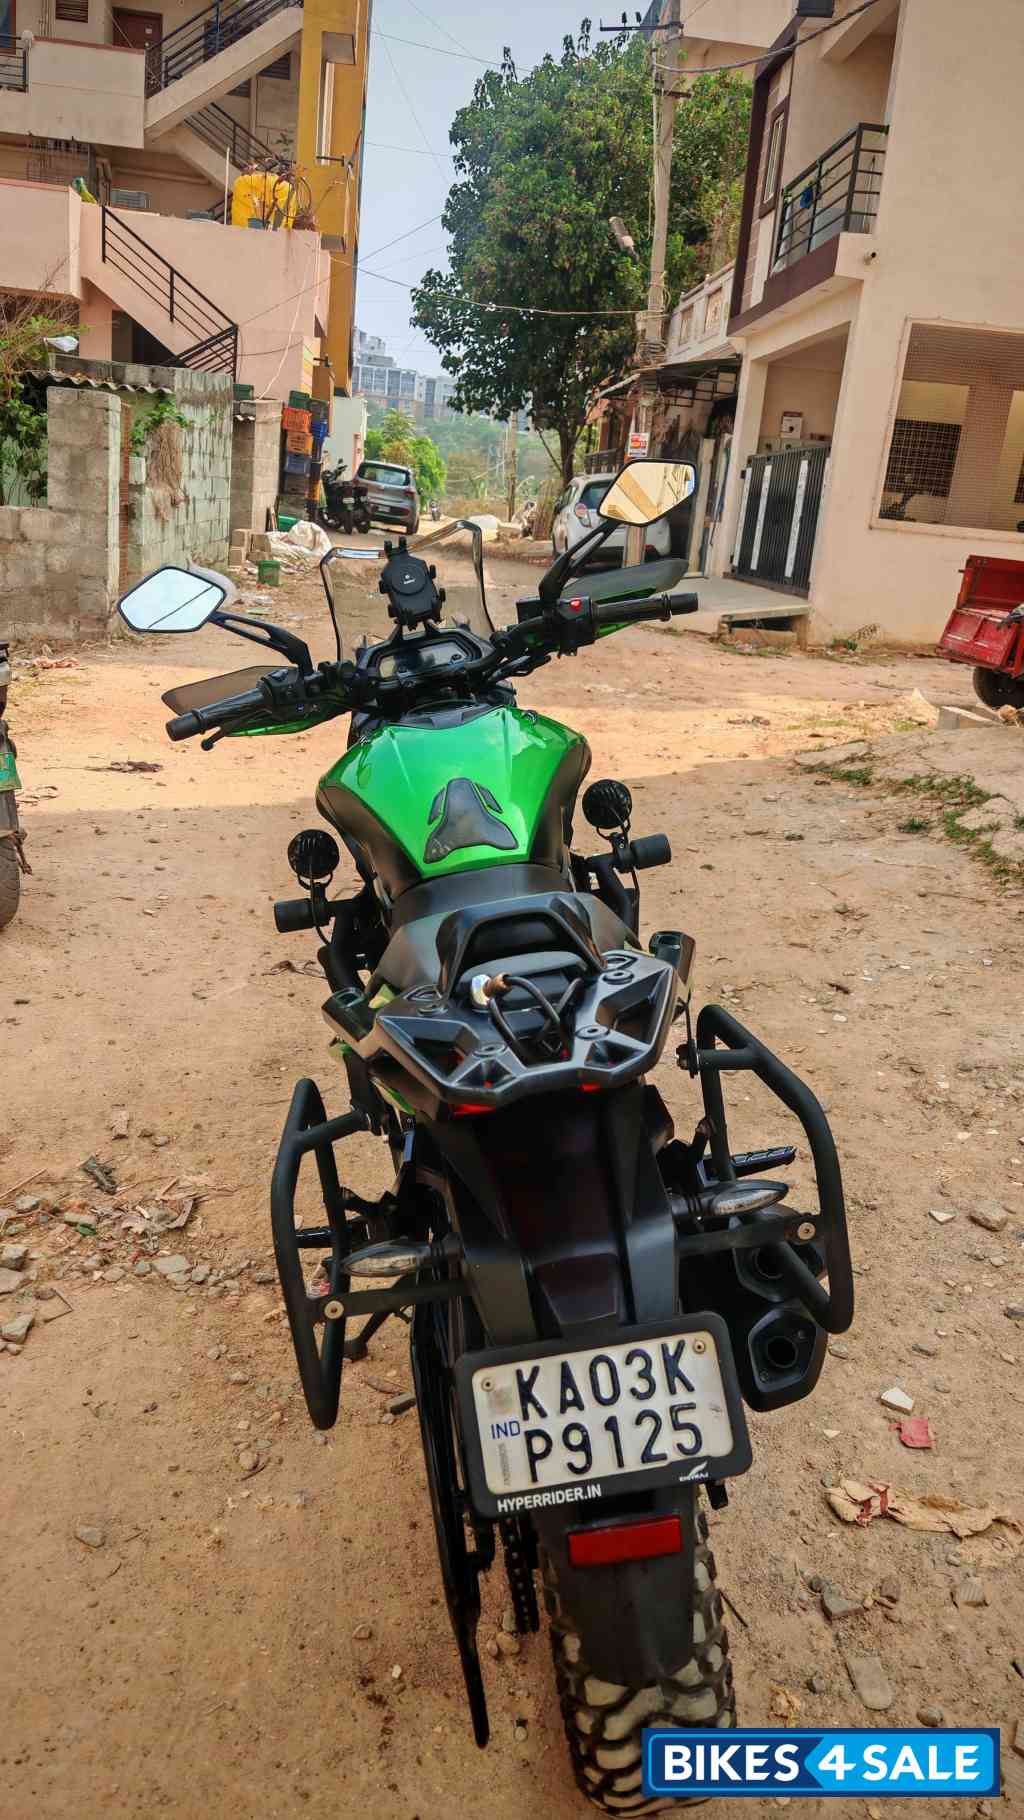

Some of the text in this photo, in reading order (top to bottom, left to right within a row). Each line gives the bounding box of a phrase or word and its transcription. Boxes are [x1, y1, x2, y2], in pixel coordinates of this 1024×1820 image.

[515, 1339, 695, 1421] KA03K
[491, 1420, 520, 1440] IND
[523, 1402, 703, 1483] P9125
[497, 1484, 602, 1513] HYPERRIDER.IN
